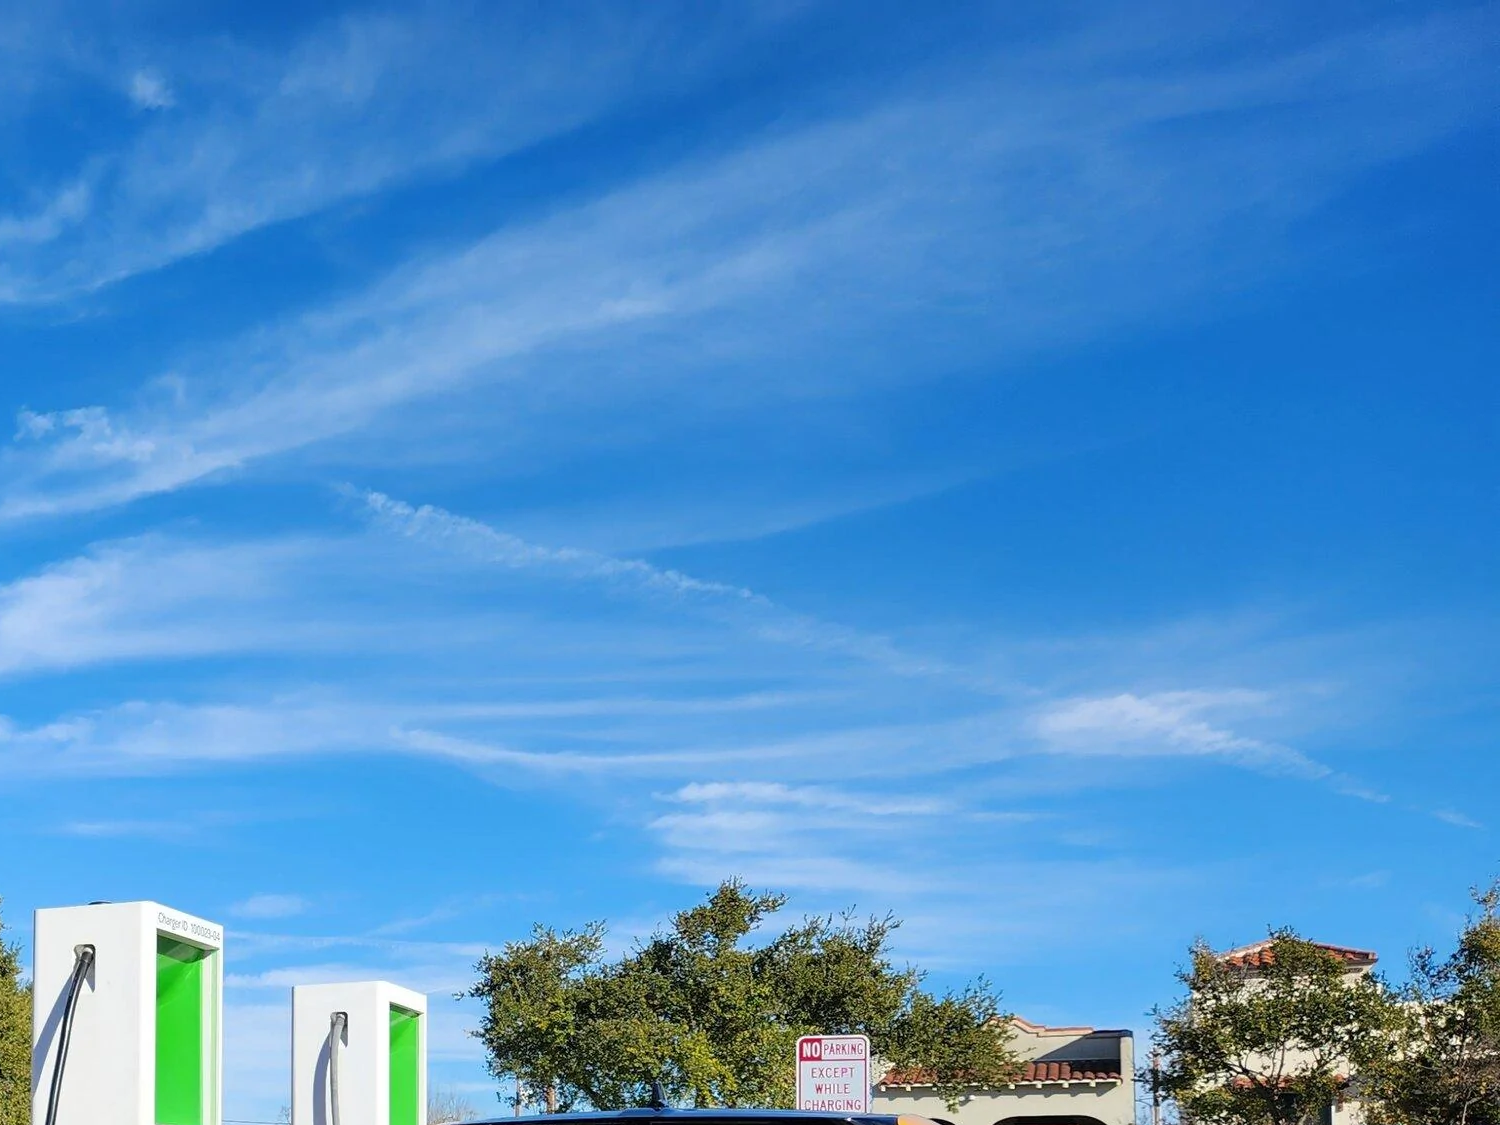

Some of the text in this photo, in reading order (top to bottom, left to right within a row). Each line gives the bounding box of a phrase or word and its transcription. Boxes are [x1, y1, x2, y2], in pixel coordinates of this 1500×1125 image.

[157, 911, 181, 930] Charger
[802, 1042, 863, 1058] NO PARKING
[811, 1067, 855, 1079] EXCEPT
[815, 1083, 851, 1095] WHILE
[804, 1099, 862, 1111] CHARGING
